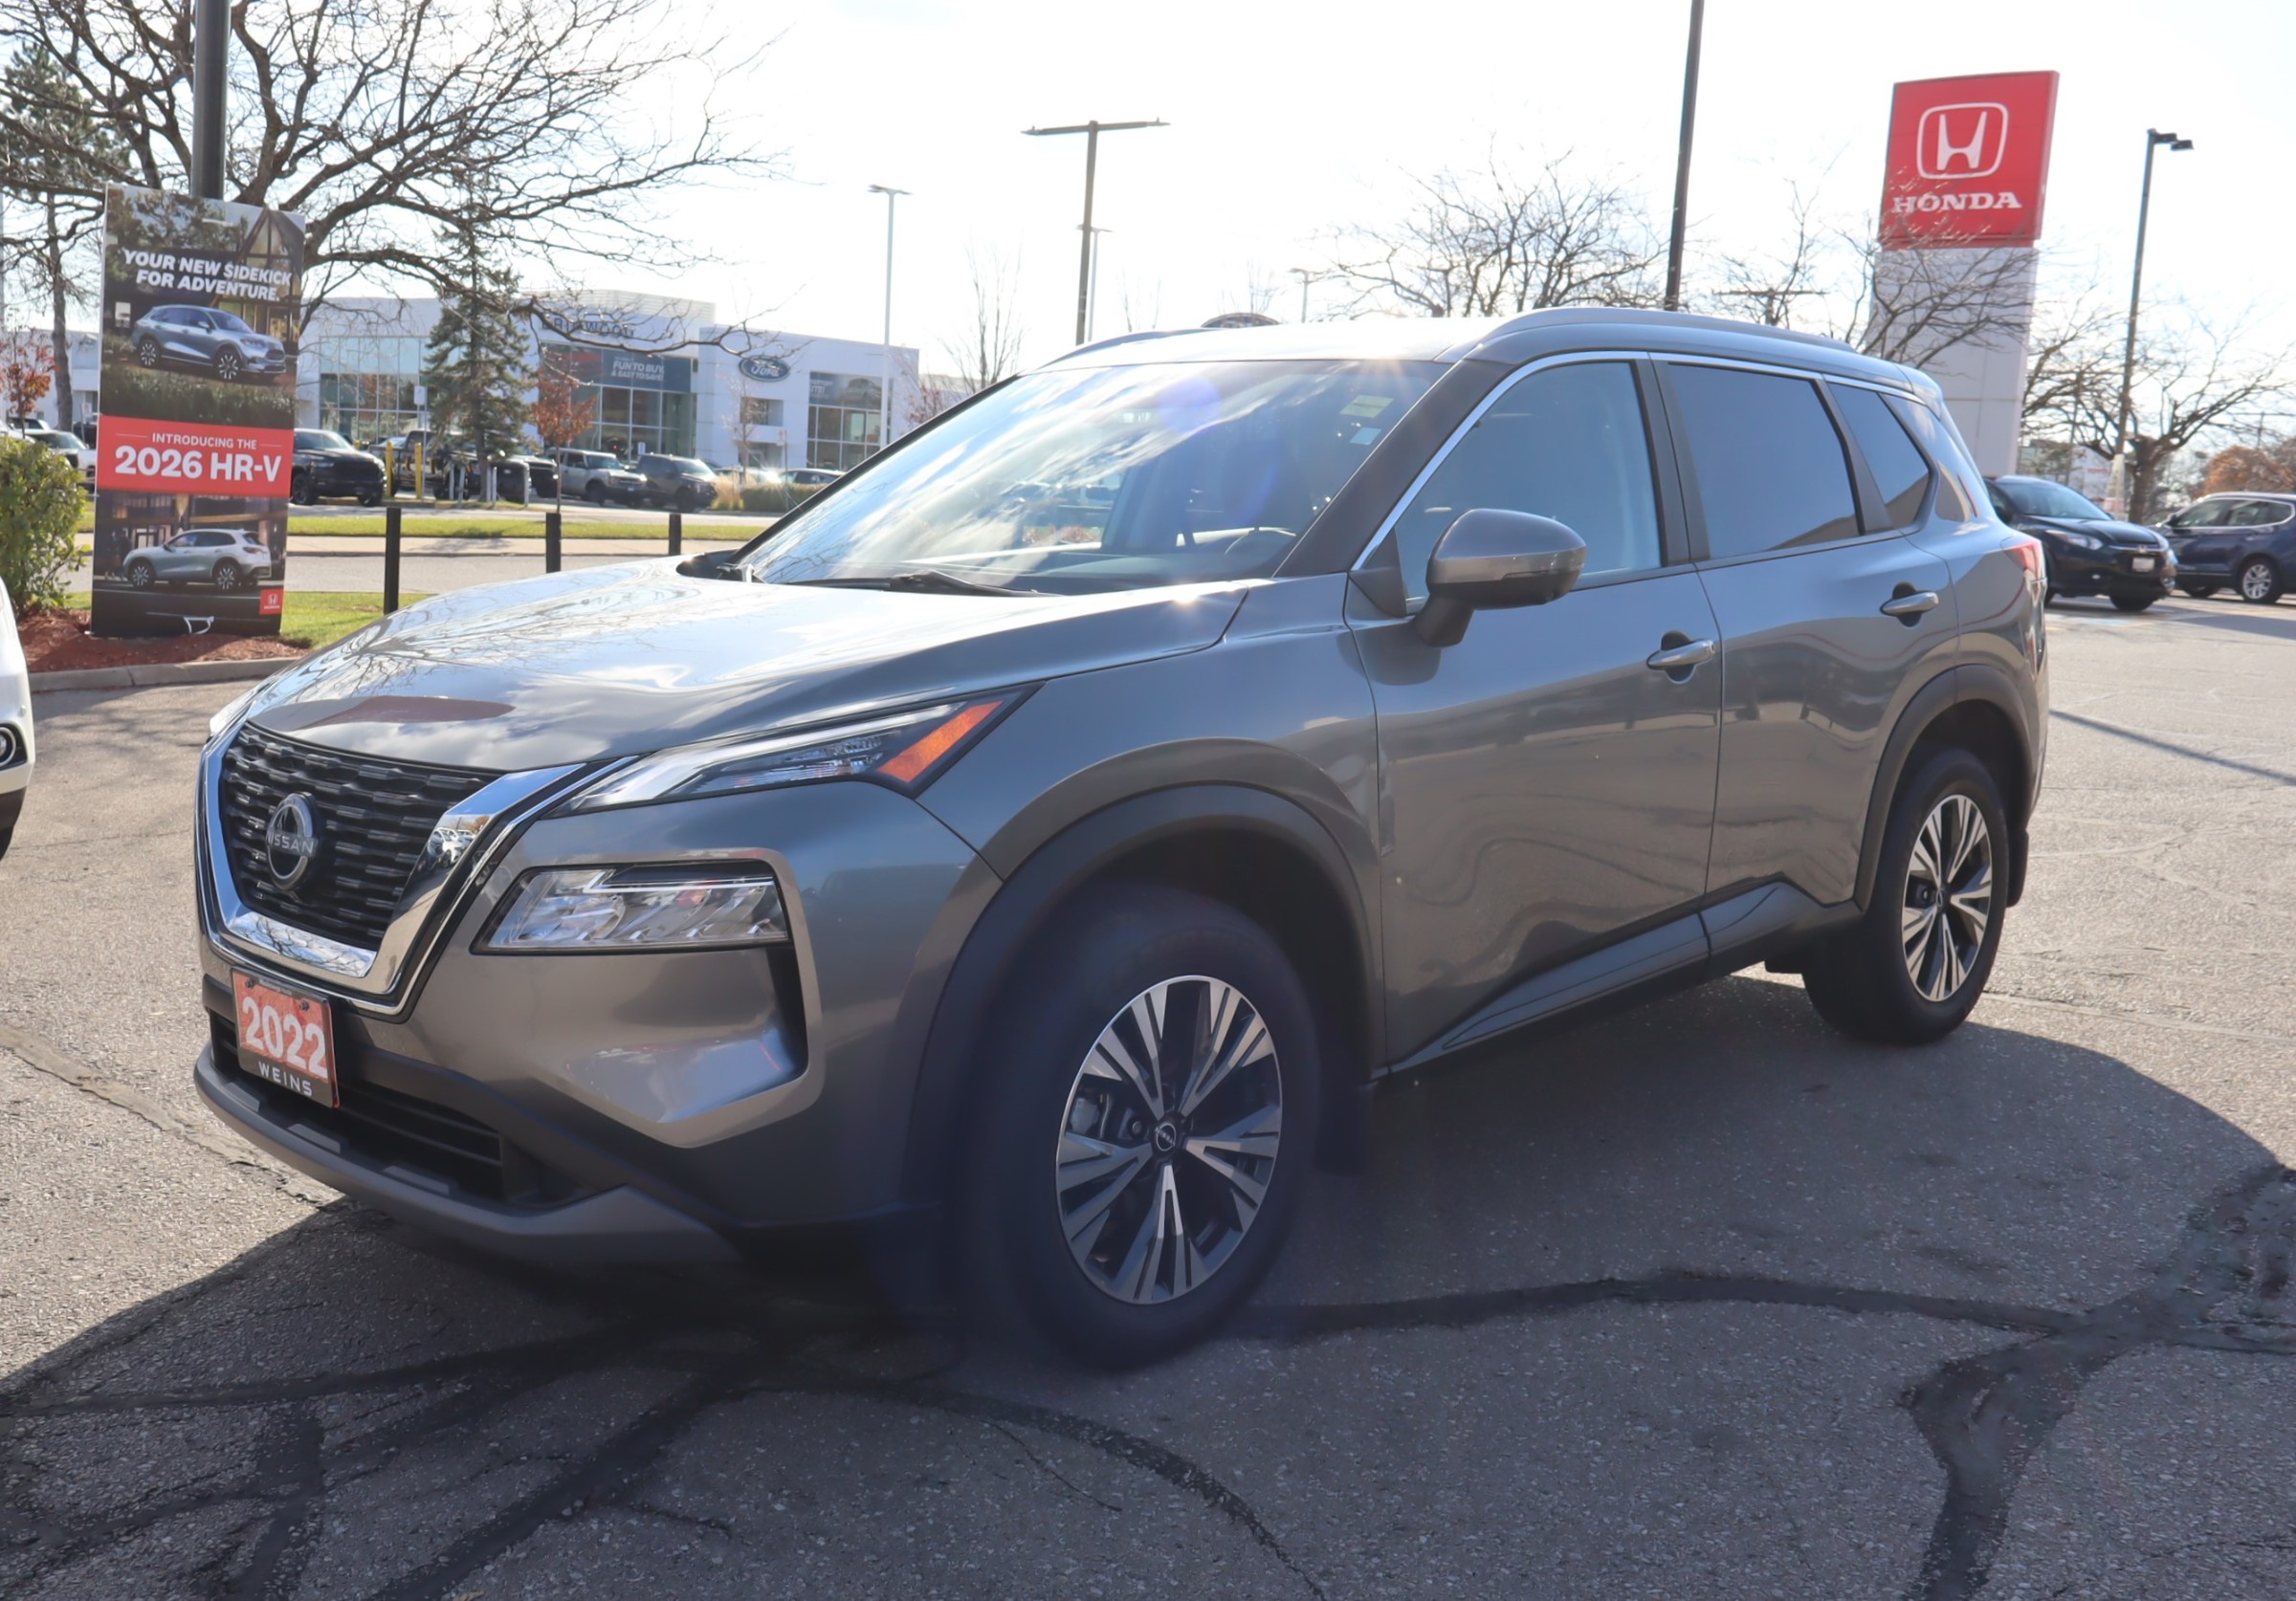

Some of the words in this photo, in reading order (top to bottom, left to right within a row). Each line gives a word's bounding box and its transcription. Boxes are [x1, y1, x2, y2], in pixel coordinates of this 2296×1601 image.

[1892, 192, 2021, 213] HONDA
[121, 248, 175, 271] YOUR
[179, 257, 221, 276] NEW
[223, 263, 292, 286] SIDEKICK
[136, 270, 174, 287] FOR
[177, 276, 280, 301] ADVENTURE.
[613, 360, 631, 370] FUN
[632, 362, 645, 372] TO
[152, 432, 234, 449] INTRODUCING
[237, 438, 257, 450] THE
[115, 446, 203, 479] 2026
[210, 452, 282, 482] HR-V
[266, 829, 314, 854] NISSAN
[242, 997, 328, 1080] 2022
[258, 1061, 313, 1097] WEINS
